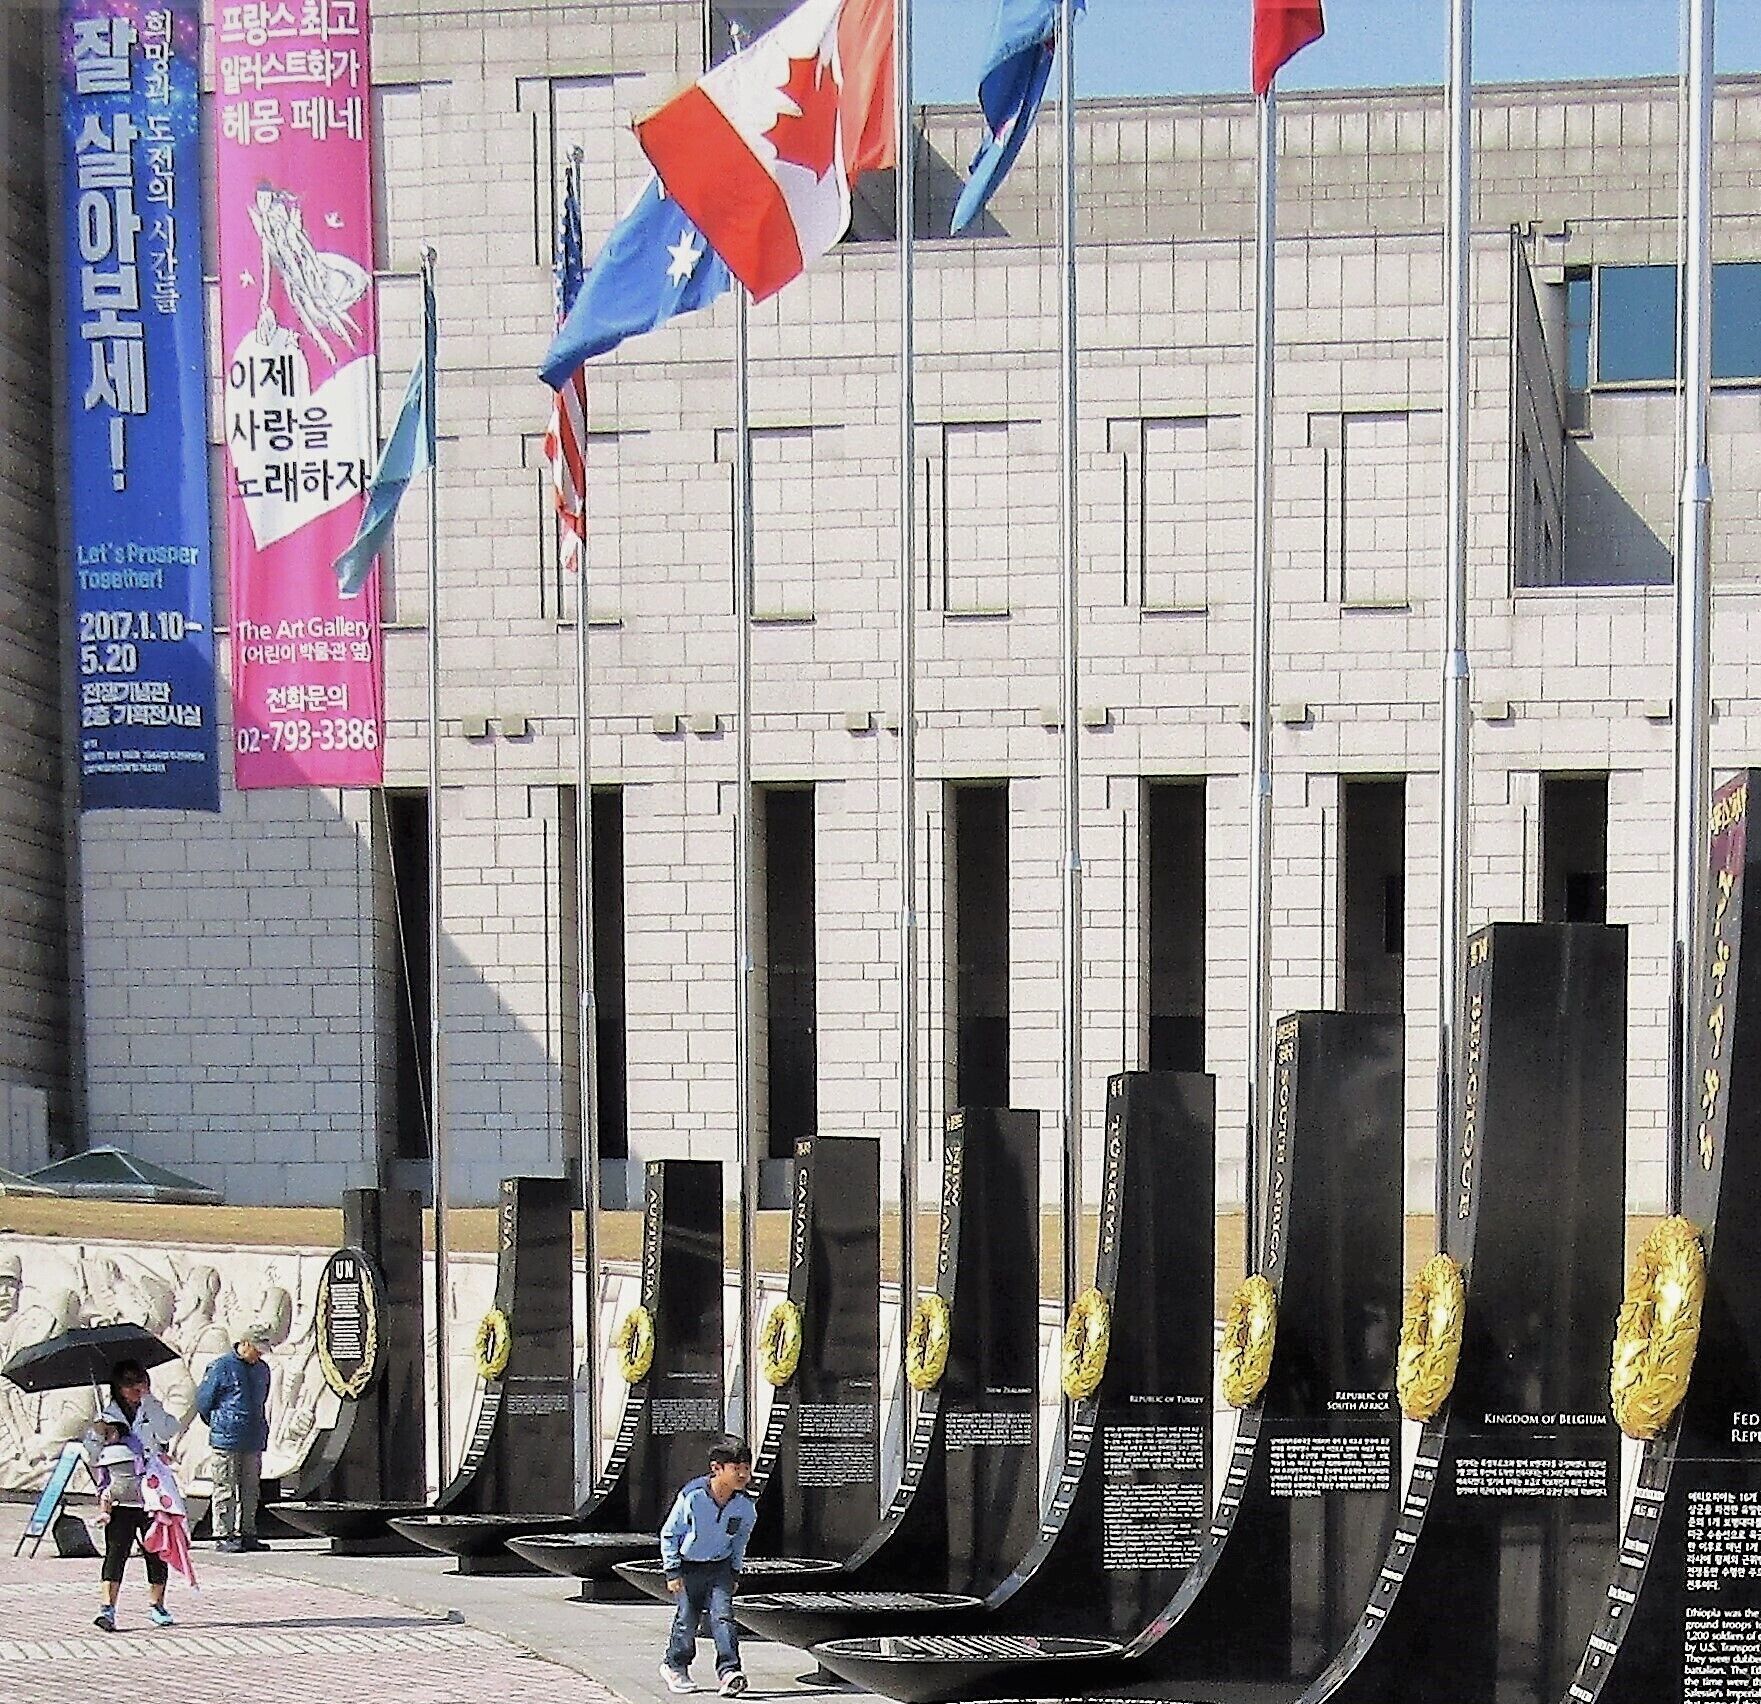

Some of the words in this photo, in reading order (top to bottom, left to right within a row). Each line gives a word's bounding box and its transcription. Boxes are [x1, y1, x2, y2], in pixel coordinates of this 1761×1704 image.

[220, 2, 298, 46] 프랑스
[299, 0, 360, 42] 최고
[73, 16, 139, 94] 잘
[144, 9, 174, 105] 희망과
[220, 49, 361, 95] 일러스트화가
[223, 99, 285, 145] 헤몽
[290, 96, 362, 140] 페네
[146, 115, 176, 210] 도전의
[149, 214, 180, 314] 시간들
[230, 355, 295, 398] 이제
[231, 407, 332, 451] 사랑을
[231, 459, 372, 502] 노래하자
[238, 620, 271, 641] The
[275, 619, 304, 640] Art
[308, 616, 371, 640] Gallery
[81, 644, 136, 675] 5.20
[242, 643, 296, 664] (어린이
[300, 641, 346, 662] 박물관
[351, 641, 372, 663] 옆)
[266, 684, 348, 713] 전화문의
[238, 718, 377, 753] 02-793-3386
[335, 1260, 354, 1280] UN
[1327, 1401, 1356, 1410] SOUTH
[1484, 1414, 1539, 1424] KINGDOM
[1541, 1414, 1556, 1424] OF
[1559, 1414, 1607, 1425] BELGIUM
[1686, 1607, 1721, 1619] Ethiopia
[1724, 1610, 1742, 1618] was
[1745, 1608, 1759, 1618] the
